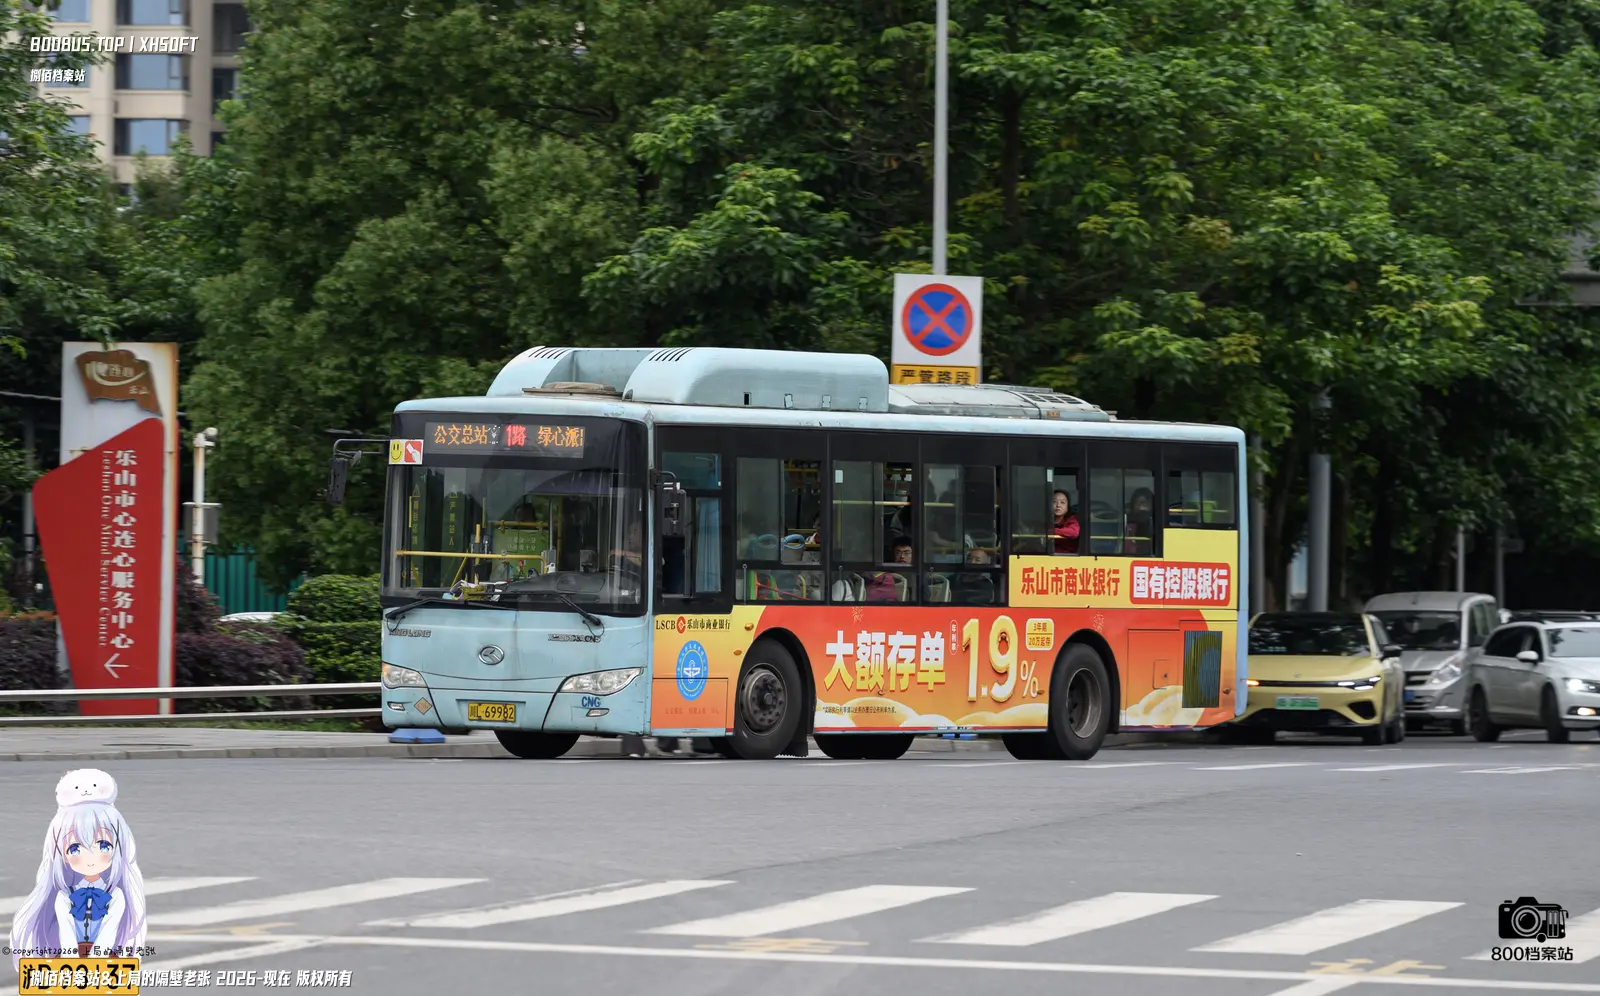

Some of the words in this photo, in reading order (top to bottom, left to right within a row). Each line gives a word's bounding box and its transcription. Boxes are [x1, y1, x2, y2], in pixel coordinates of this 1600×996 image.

[434, 424, 489, 446] 公交总站
[110, 449, 138, 649] 乐山市心连心服务中心
[1021, 566, 1120, 597] 乐山市商业银行
[1133, 566, 1228, 601] 国有控股银行
[655, 620, 676, 630] LSCB
[1028, 636, 1051, 647] 20万起存
[824, 630, 946, 692] 大额存单
[581, 696, 601, 708] CNG
